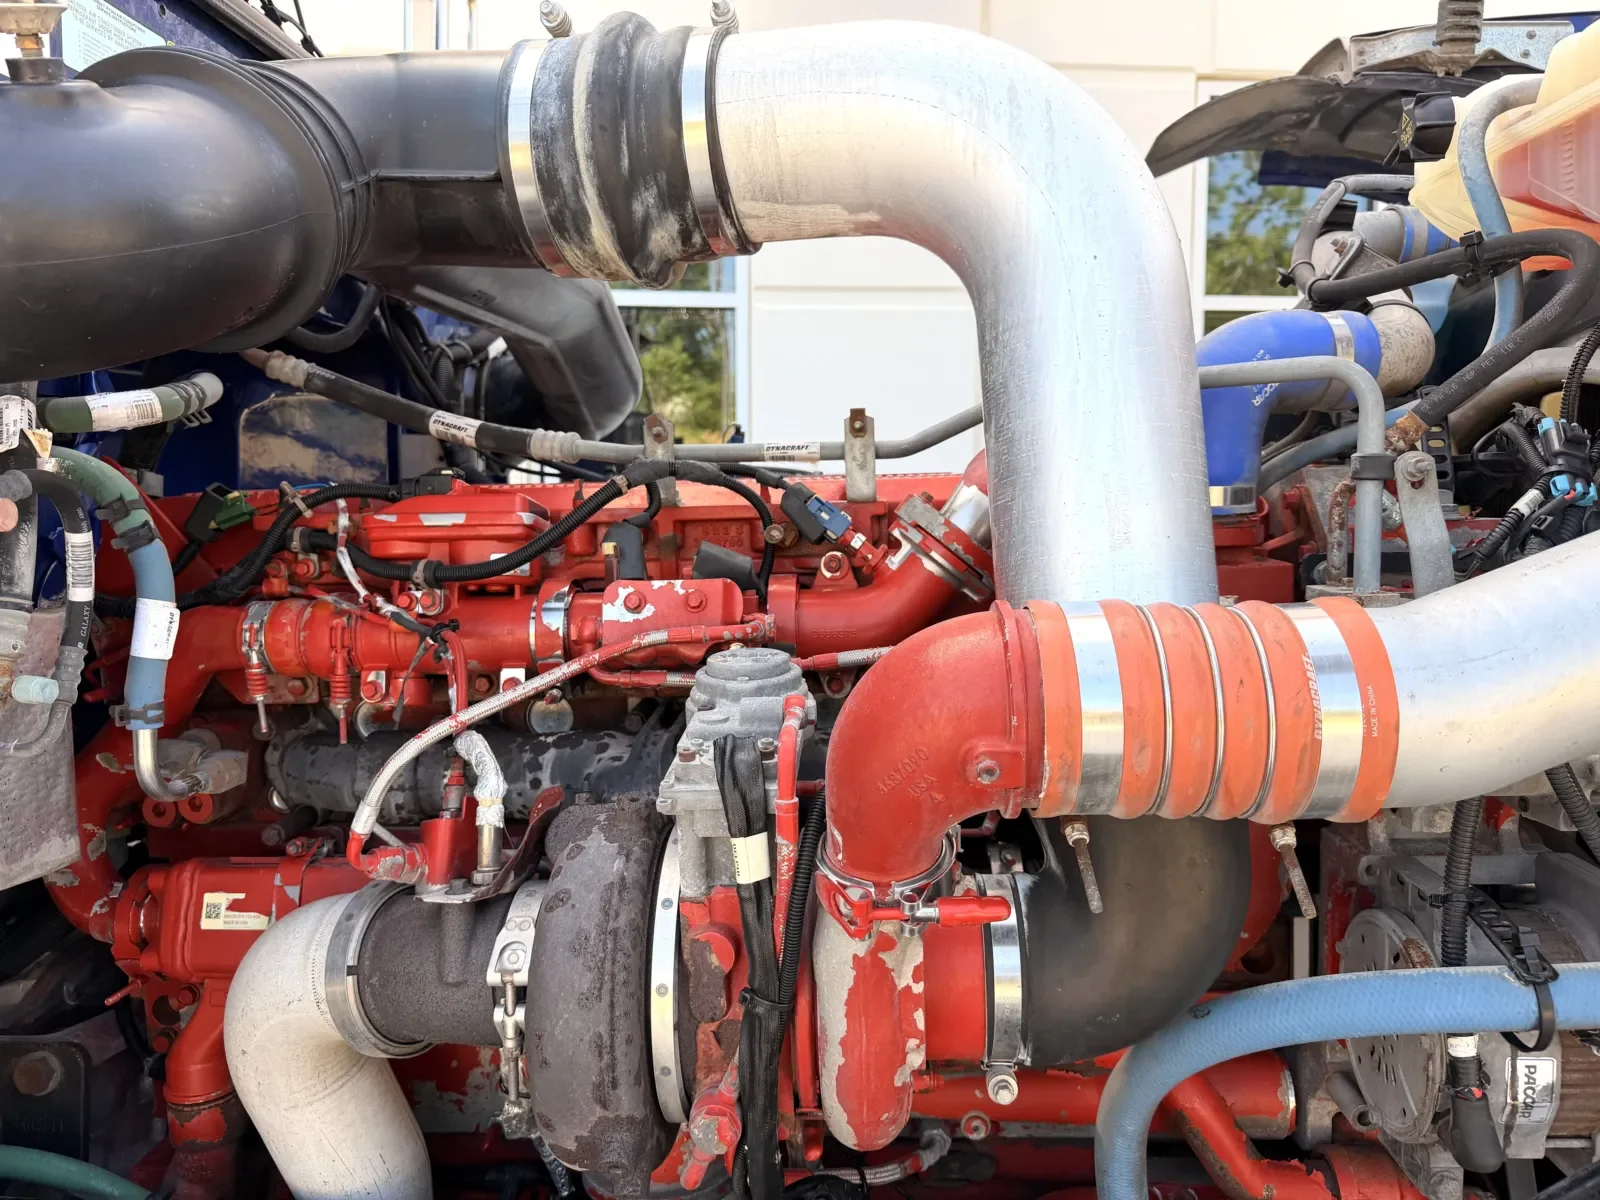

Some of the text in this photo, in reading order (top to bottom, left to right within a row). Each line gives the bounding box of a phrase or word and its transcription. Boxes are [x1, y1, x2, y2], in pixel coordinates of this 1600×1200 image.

[1480, 356, 1496, 370] PET
[1252, 383, 1280, 406] CCAR
[432, 418, 469, 433] DYNACRAFT
[765, 444, 810, 452] DYNACRAFT
[80, 605, 91, 637] GALAXY
[1366, 684, 1379, 738] MADE IN CHINA
[906, 773, 938, 798] USA
[1518, 1064, 1537, 1119] PACCAR
